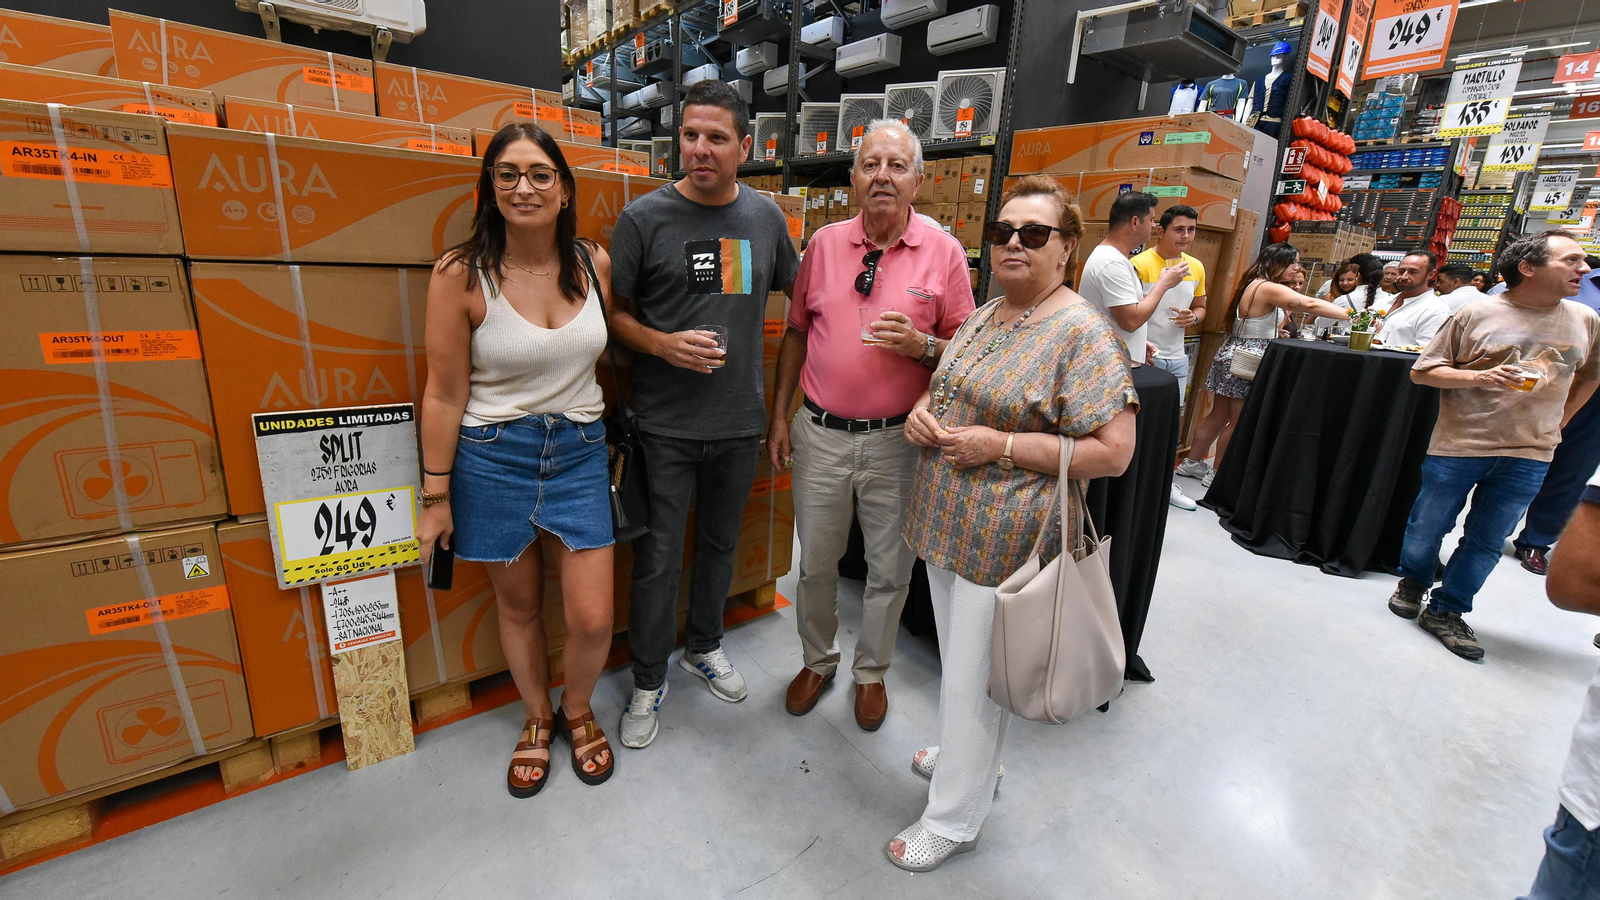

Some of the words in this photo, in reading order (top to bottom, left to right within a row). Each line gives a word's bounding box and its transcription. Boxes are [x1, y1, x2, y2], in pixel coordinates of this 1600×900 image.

[1388, 12, 1431, 50] 249
[1436, 8, 1444, 21] €
[127, 28, 214, 64] AURA
[1455, 62, 1487, 70] UNIDADES
[1487, 57, 1522, 65] LIMITADAS
[1564, 60, 1589, 76] 14
[387, 77, 448, 103] AURA
[1457, 100, 1493, 126] 135
[1578, 101, 1600, 114] 16
[243, 112, 320, 138] AURA
[12, 146, 98, 162] AR35TK4-IN
[1018, 142, 1052, 156] AURA
[1500, 145, 1524, 164] 120
[198, 152, 338, 199] AURA
[1544, 192, 1561, 204] 45
[224, 205, 246, 214] A++
[52, 335, 124, 344] AR35TK4-OUT
[259, 366, 398, 409] AURA
[259, 417, 335, 432] UNIDADES
[338, 412, 410, 426] LIMITADAS
[319, 431, 364, 464] SPLIT
[310, 466, 333, 482] 2752
[334, 462, 377, 478] FRIGORIAS
[335, 479, 359, 494] AURA
[314, 496, 377, 556] 249
[386, 493, 396, 512] €
[314, 566, 334, 574] Solo
[336, 564, 349, 572] 60
[352, 560, 371, 569] Uds
[98, 600, 162, 616] AR35TK4-OUT
[352, 623, 385, 638] NACIONAL
[346, 638, 368, 646] VENTAJAS
[369, 632, 392, 642] PRODUCTO
